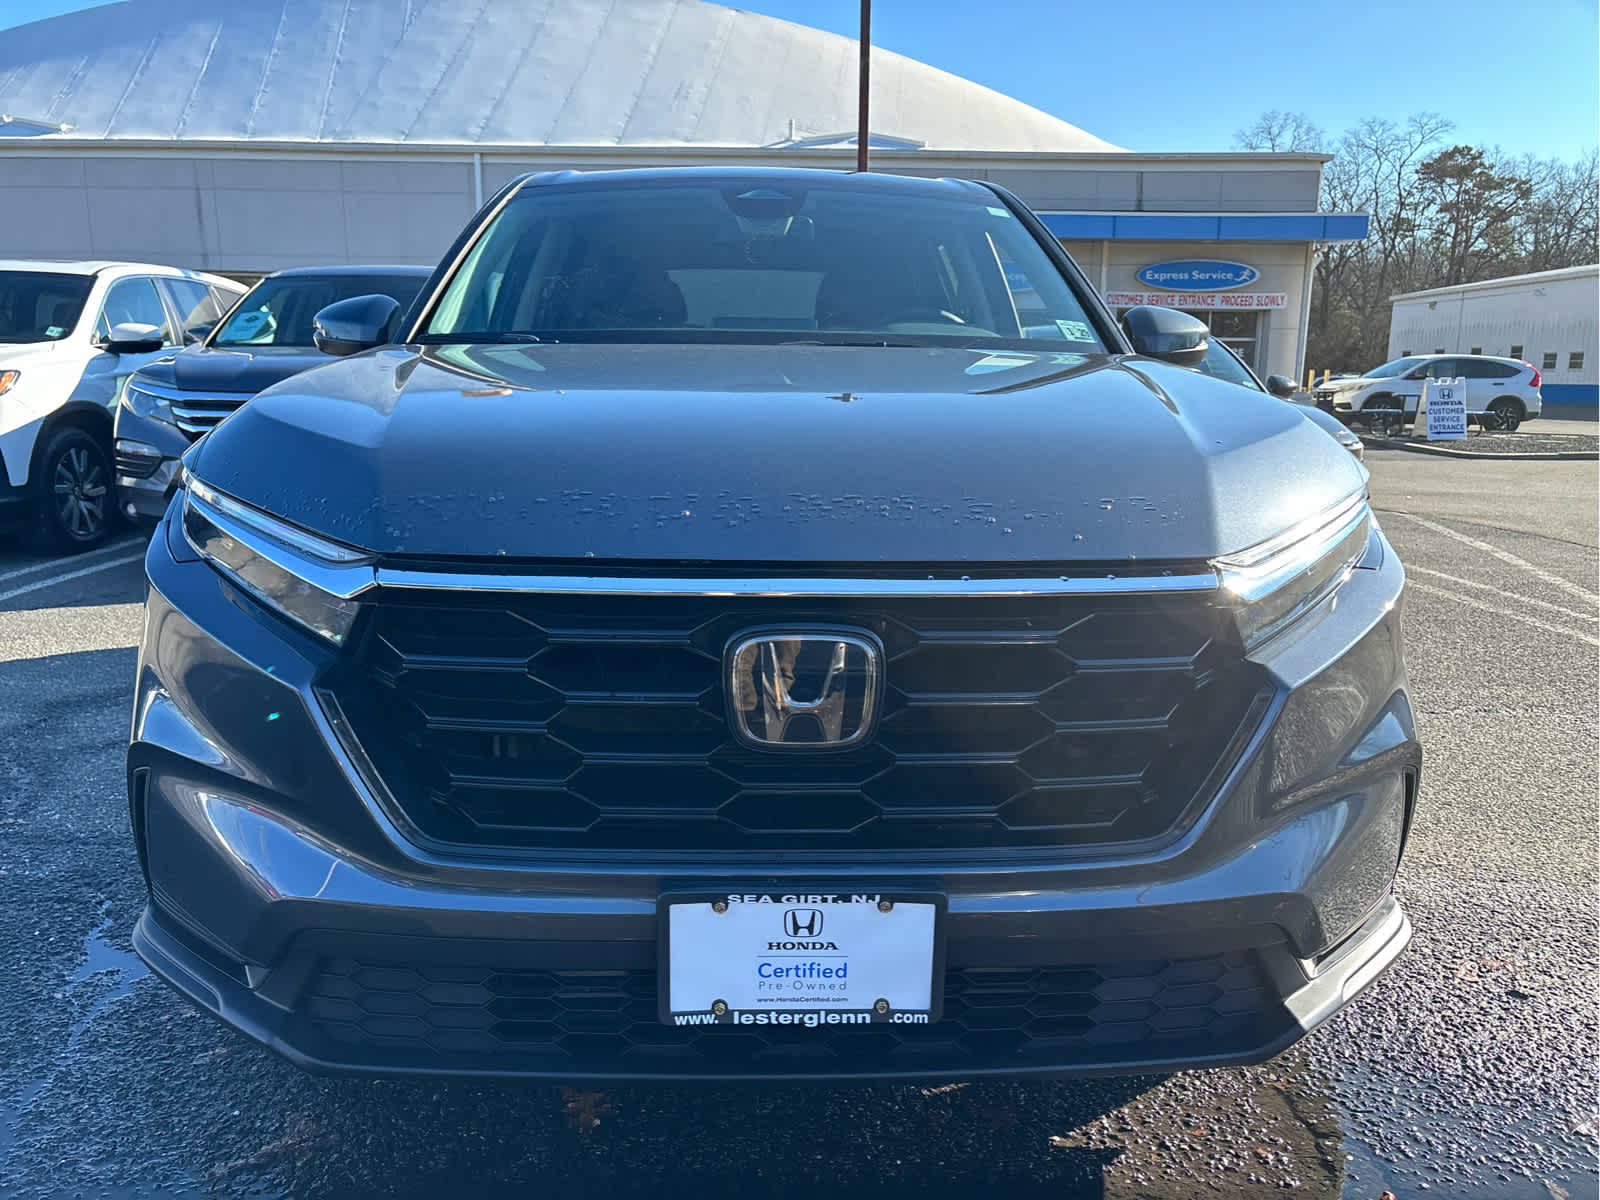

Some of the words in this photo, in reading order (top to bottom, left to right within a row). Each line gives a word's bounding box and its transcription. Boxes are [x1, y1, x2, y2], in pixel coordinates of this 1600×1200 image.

[1146, 270, 1189, 282] Express
[1192, 270, 1234, 280] Service
[1106, 294, 1143, 305] CUSTOMER
[1147, 294, 1176, 306] SERVICE
[1178, 294, 1216, 306] ENTRANCE
[1221, 295, 1253, 306] PROCEED
[1256, 295, 1285, 306] SLOWLY
[1428, 407, 1465, 415] CUSTOMER
[1433, 415, 1461, 423] SERVICE
[1429, 423, 1465, 431] ENTRANCE
[727, 894, 774, 904] SEA
[851, 894, 881, 904] NJ
[767, 941, 839, 951] HONDA
[758, 962, 847, 979] Certified
[758, 980, 847, 991] Pre-Owned
[674, 1014, 719, 1025] www.
[733, 1010, 872, 1028] lesterglenn
[888, 1012, 929, 1024] .com
